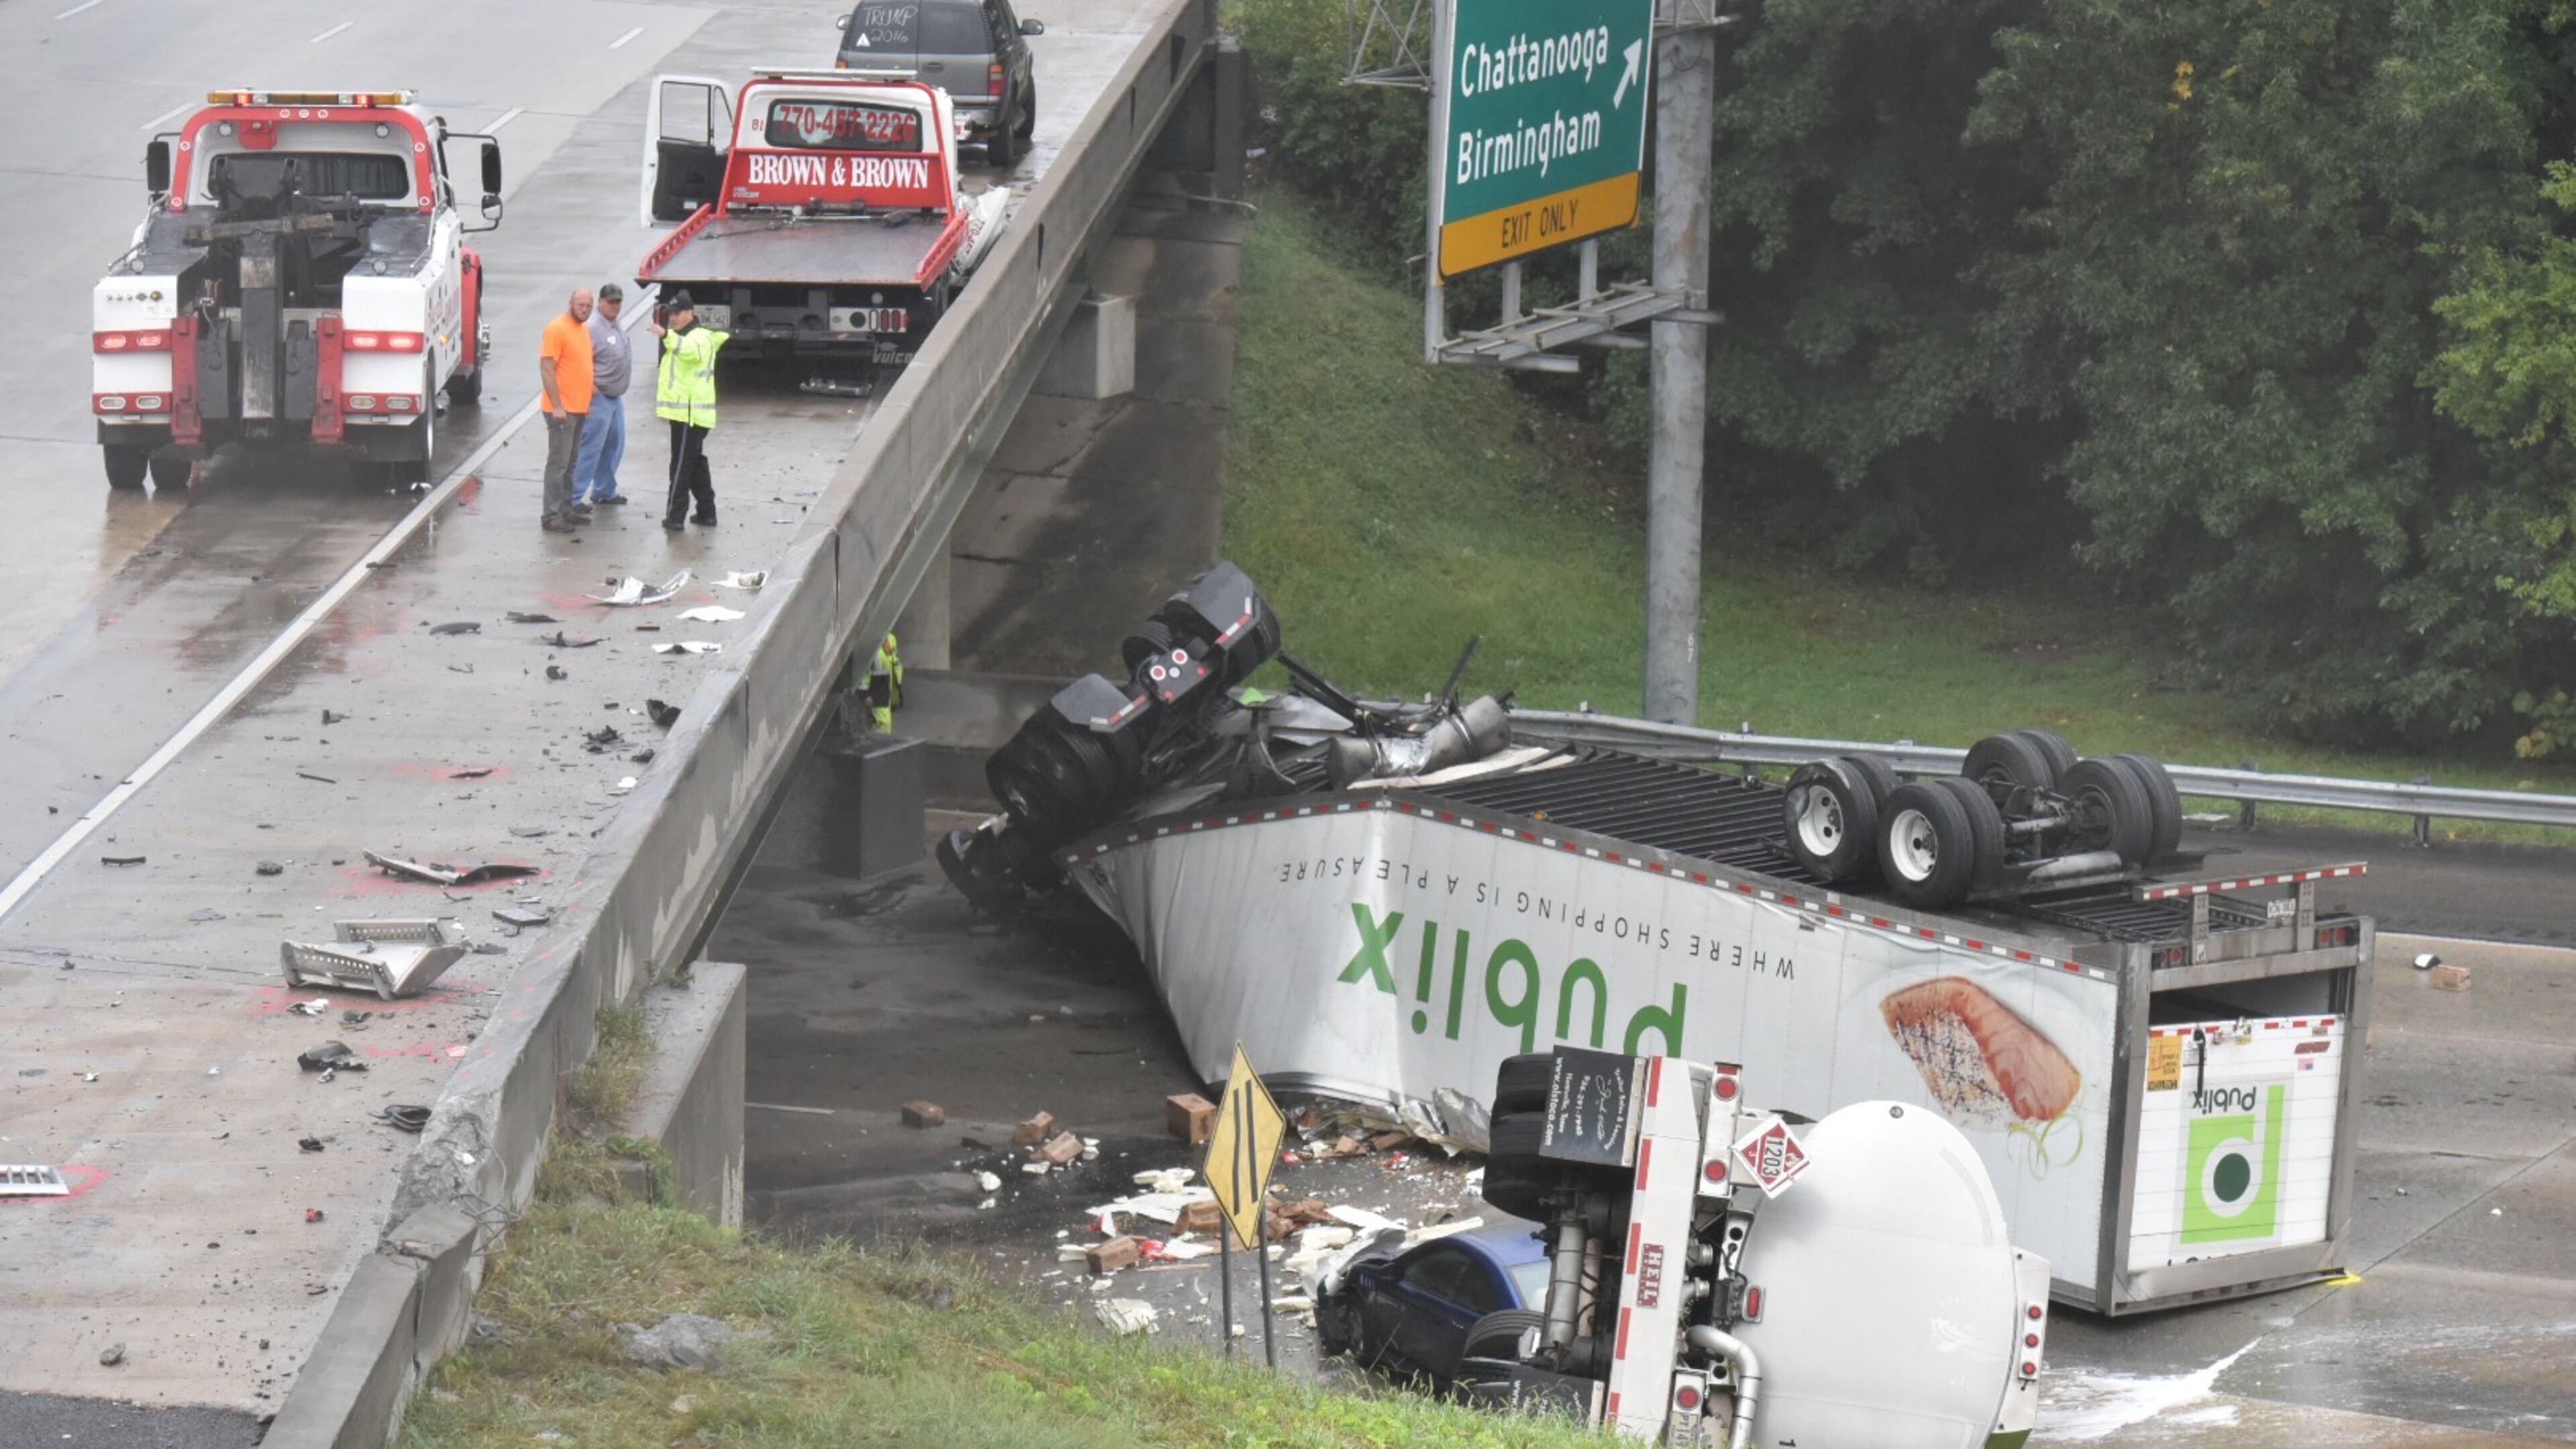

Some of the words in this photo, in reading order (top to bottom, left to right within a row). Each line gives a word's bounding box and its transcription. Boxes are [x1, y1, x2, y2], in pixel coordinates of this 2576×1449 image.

[863, 5, 918, 26] TRUMP
[871, 28, 908, 42] 2016
[1460, 25, 1608, 97] Chattanooga
[780, 105, 915, 142] 770-457-2226
[1457, 109, 1600, 185] Birmingham
[749, 154, 826, 185] BROWN
[832, 157, 846, 186] &
[851, 158, 929, 189] BROWN
[1502, 211, 1532, 248] EXIT
[1540, 199, 1578, 237] ONLY
[1280, 856, 1429, 889] PLEASURE
[1447, 875, 1458, 895] A
[1477, 882, 1499, 906] IS
[1517, 890, 1670, 949] SHOPPING
[1689, 934, 1794, 980] WHERE
[1763, 1140, 1783, 1176] 1203
[1644, 1252, 1662, 1299] HEIL
